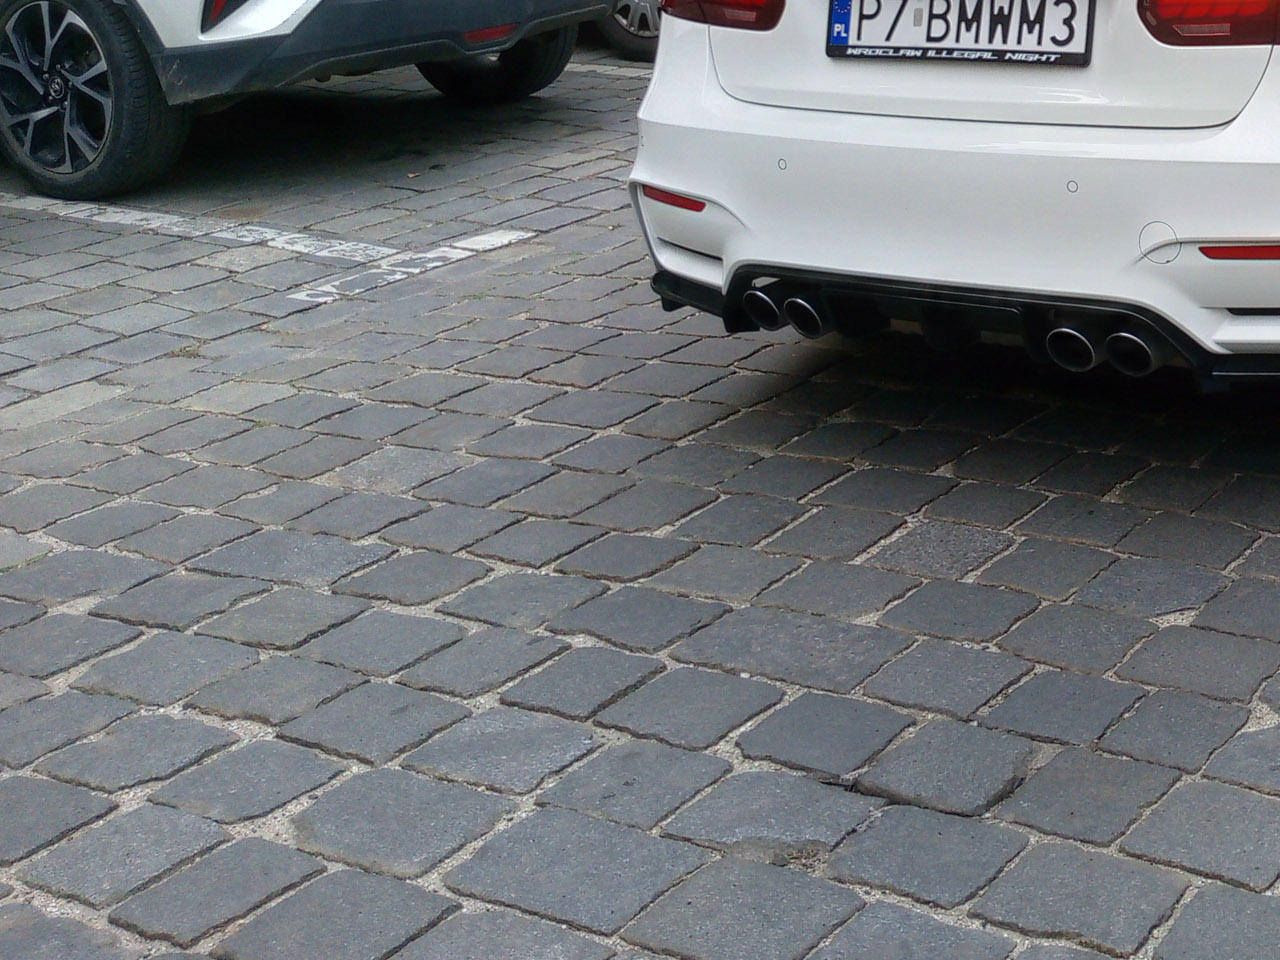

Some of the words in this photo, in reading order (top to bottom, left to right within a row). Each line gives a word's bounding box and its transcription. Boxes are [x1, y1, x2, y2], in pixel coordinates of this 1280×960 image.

[833, 23, 848, 37] PL
[846, 47, 922, 57] WROCLAW
[926, 49, 999, 60] ILLEGAL
[1004, 52, 1061, 62] NIGHT
